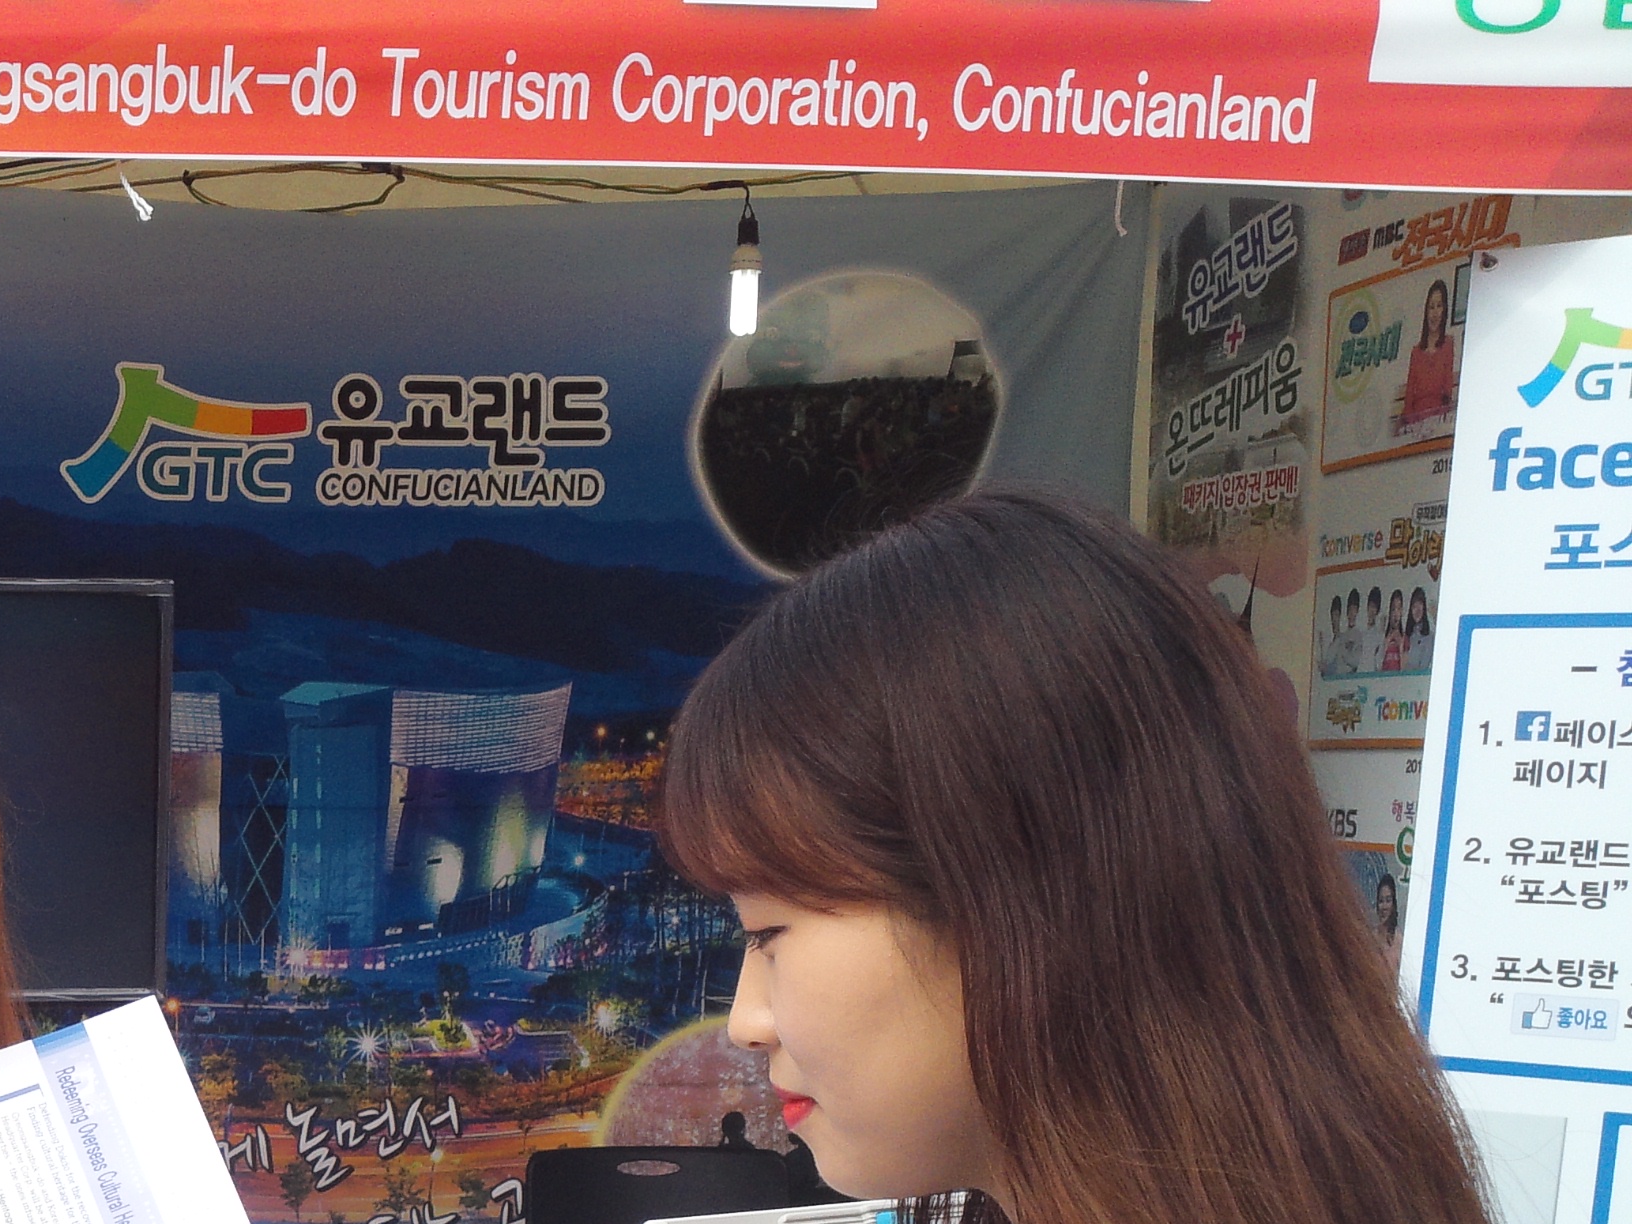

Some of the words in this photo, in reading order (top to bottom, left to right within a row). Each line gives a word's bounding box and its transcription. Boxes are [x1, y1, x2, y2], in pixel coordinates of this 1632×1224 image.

[382, 47, 589, 121] Tourism
[611, 52, 927, 140] Corporation,
[953, 62, 1315, 144] Confucianland
[1184, 202, 1296, 333] 유교랜드
[323, 378, 606, 466] 유교랜드
[1166, 342, 1302, 476] 온뜨레피움
[142, 447, 291, 498] GTC
[321, 473, 601, 502] CONFUCIANLAND
[1222, 472, 1262, 507] 입장권
[1264, 465, 1299, 500] 판매!
[1479, 720, 1503, 747] 1.
[1513, 759, 1607, 789] 페이지
[1463, 838, 1491, 864] 2.
[1505, 838, 1631, 869] 유교랜드
[1450, 954, 1478, 981] 3.
[1491, 956, 1620, 990] 포스팅한
[1557, 1007, 1608, 1031] 좋아요
[50, 1064, 94, 1126] Redeeming
[76, 1120, 113, 1172] Overseas
[95, 1168, 130, 1214] Cultural
[285, 1096, 462, 1191] 놀면서
